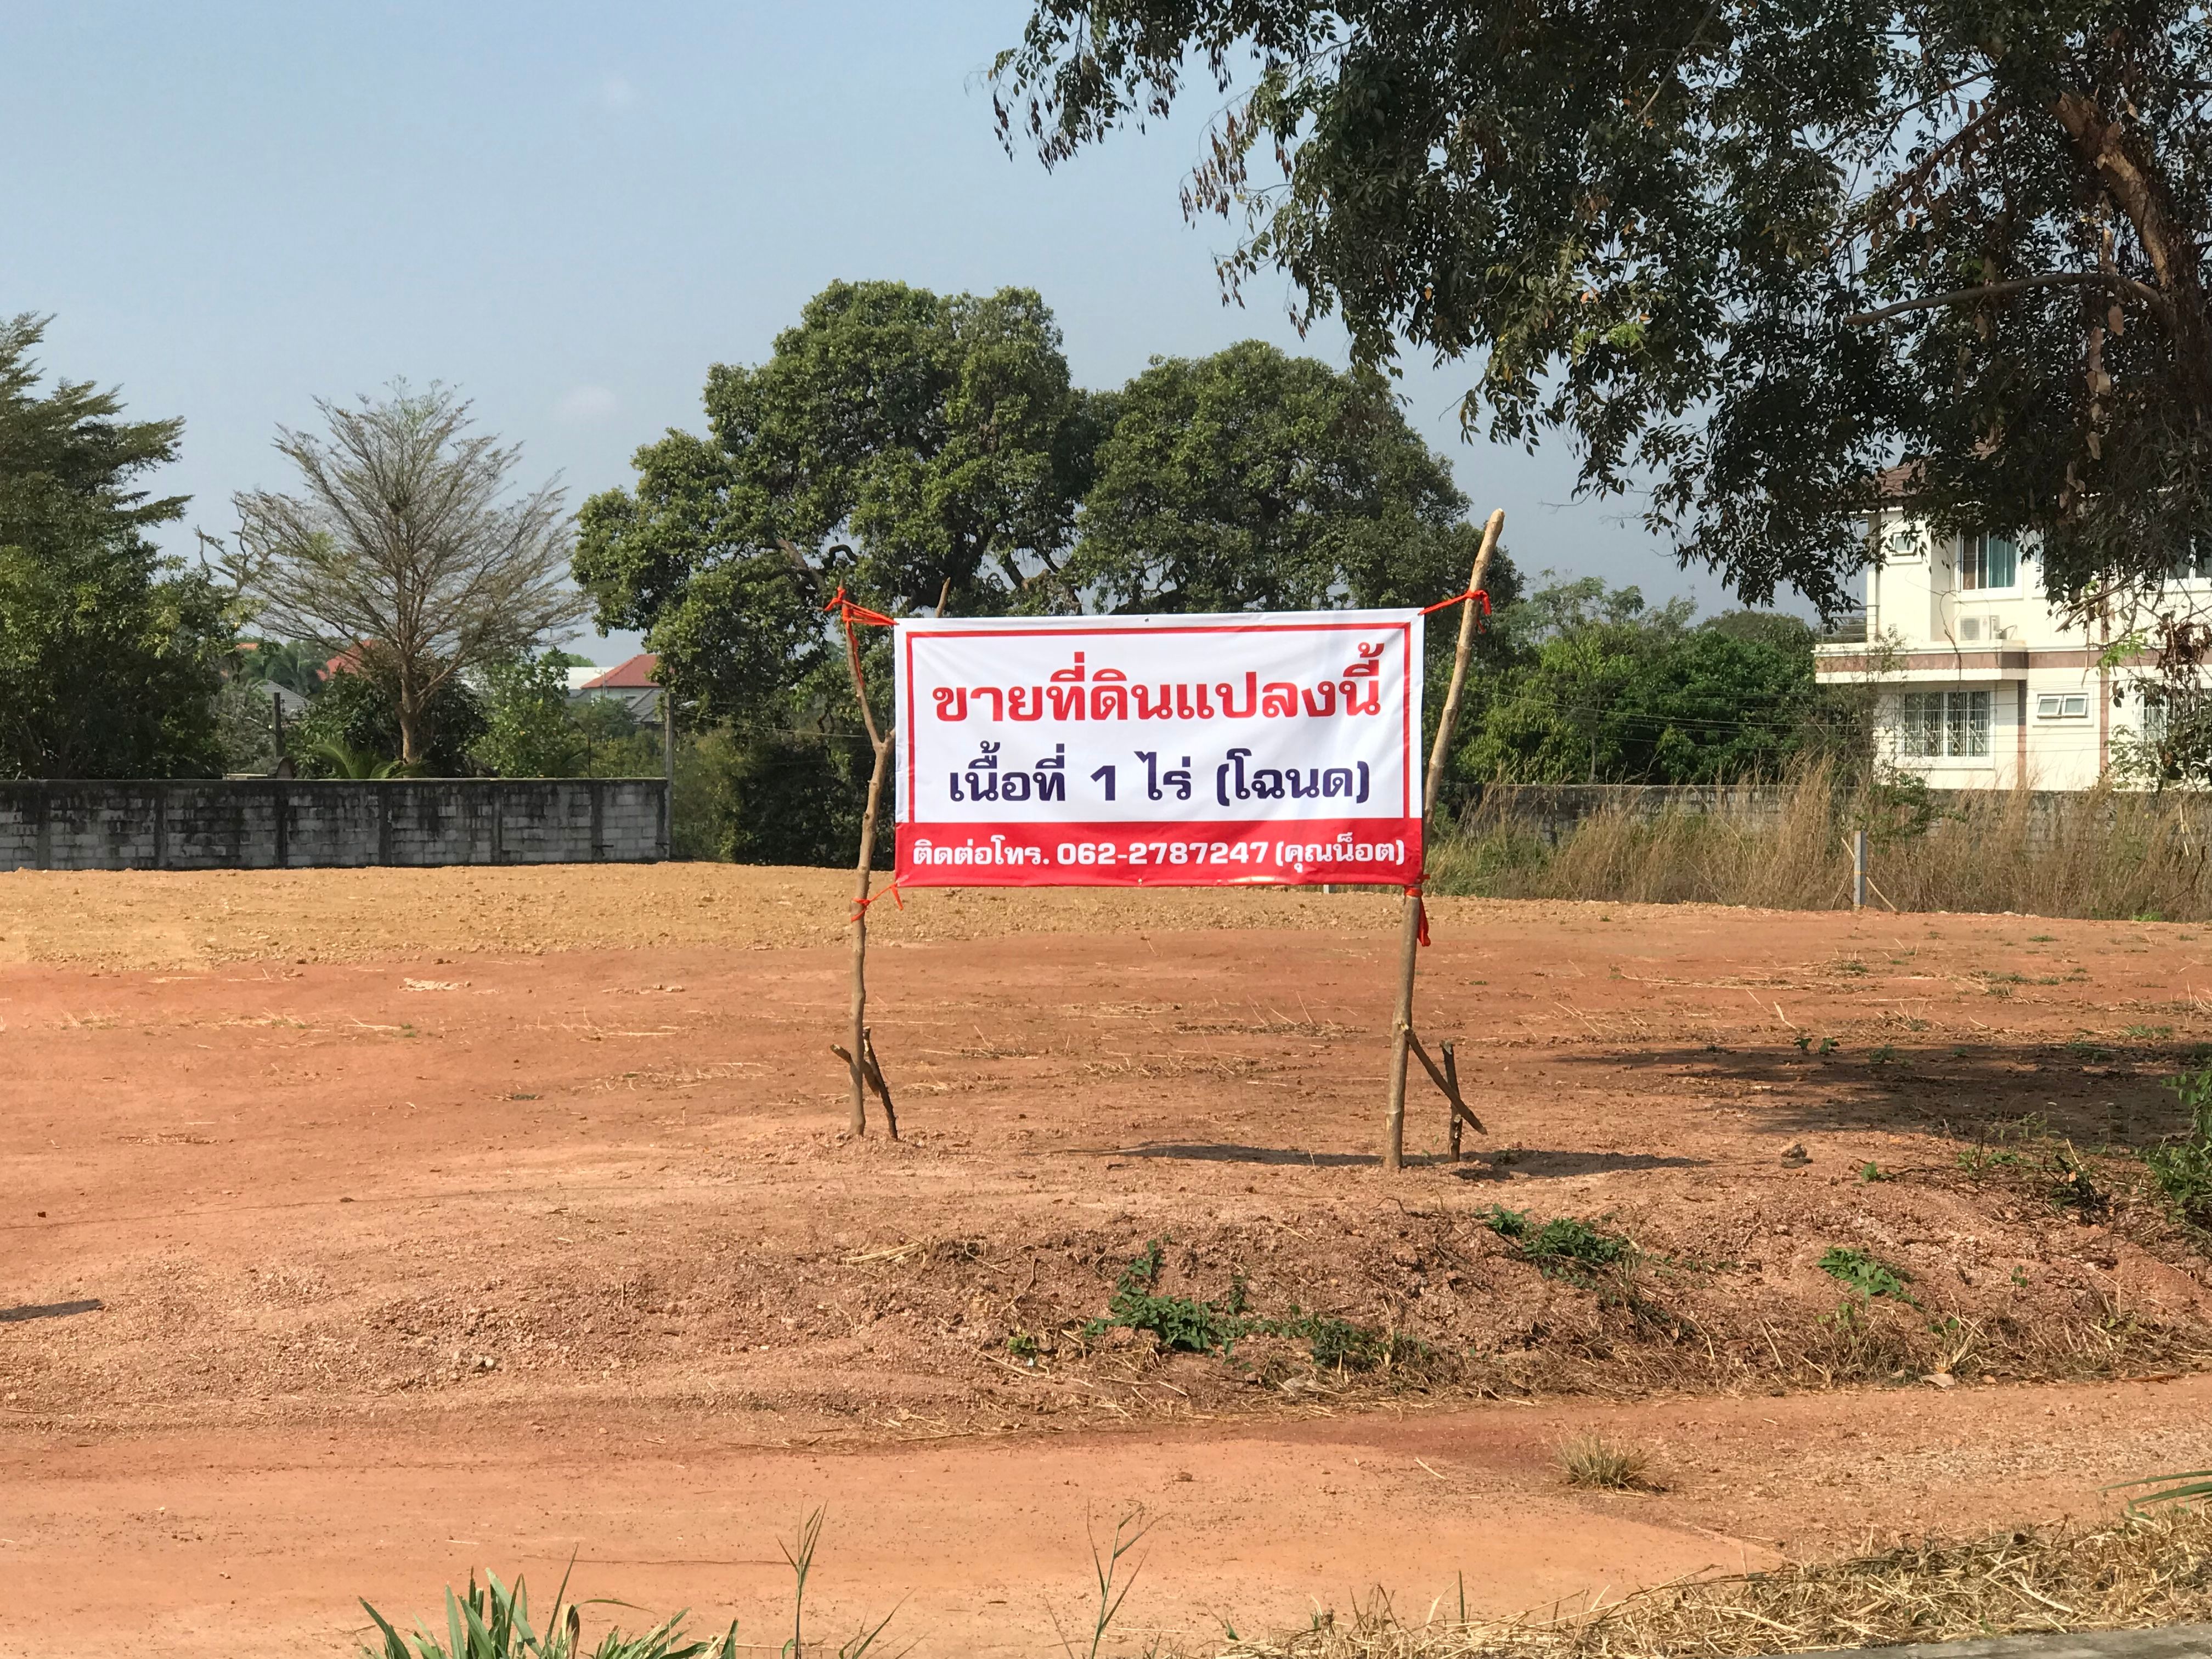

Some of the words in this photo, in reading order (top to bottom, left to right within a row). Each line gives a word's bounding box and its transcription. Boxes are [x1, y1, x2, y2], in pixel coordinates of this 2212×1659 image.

[932, 641, 1385, 723] ขายที่ดินแปลงนี้
[949, 740, 1066, 802] เนื้อที่
[1090, 764, 1116, 802] 1
[1133, 751, 1192, 801] ไร่
[1216, 747, 1370, 806] (โฉนด)
[912, 834, 1050, 866] ติดต่อโทร.
[1056, 840, 1269, 866] 062-2787247
[1274, 832, 1406, 873] (คุณน็อต)
